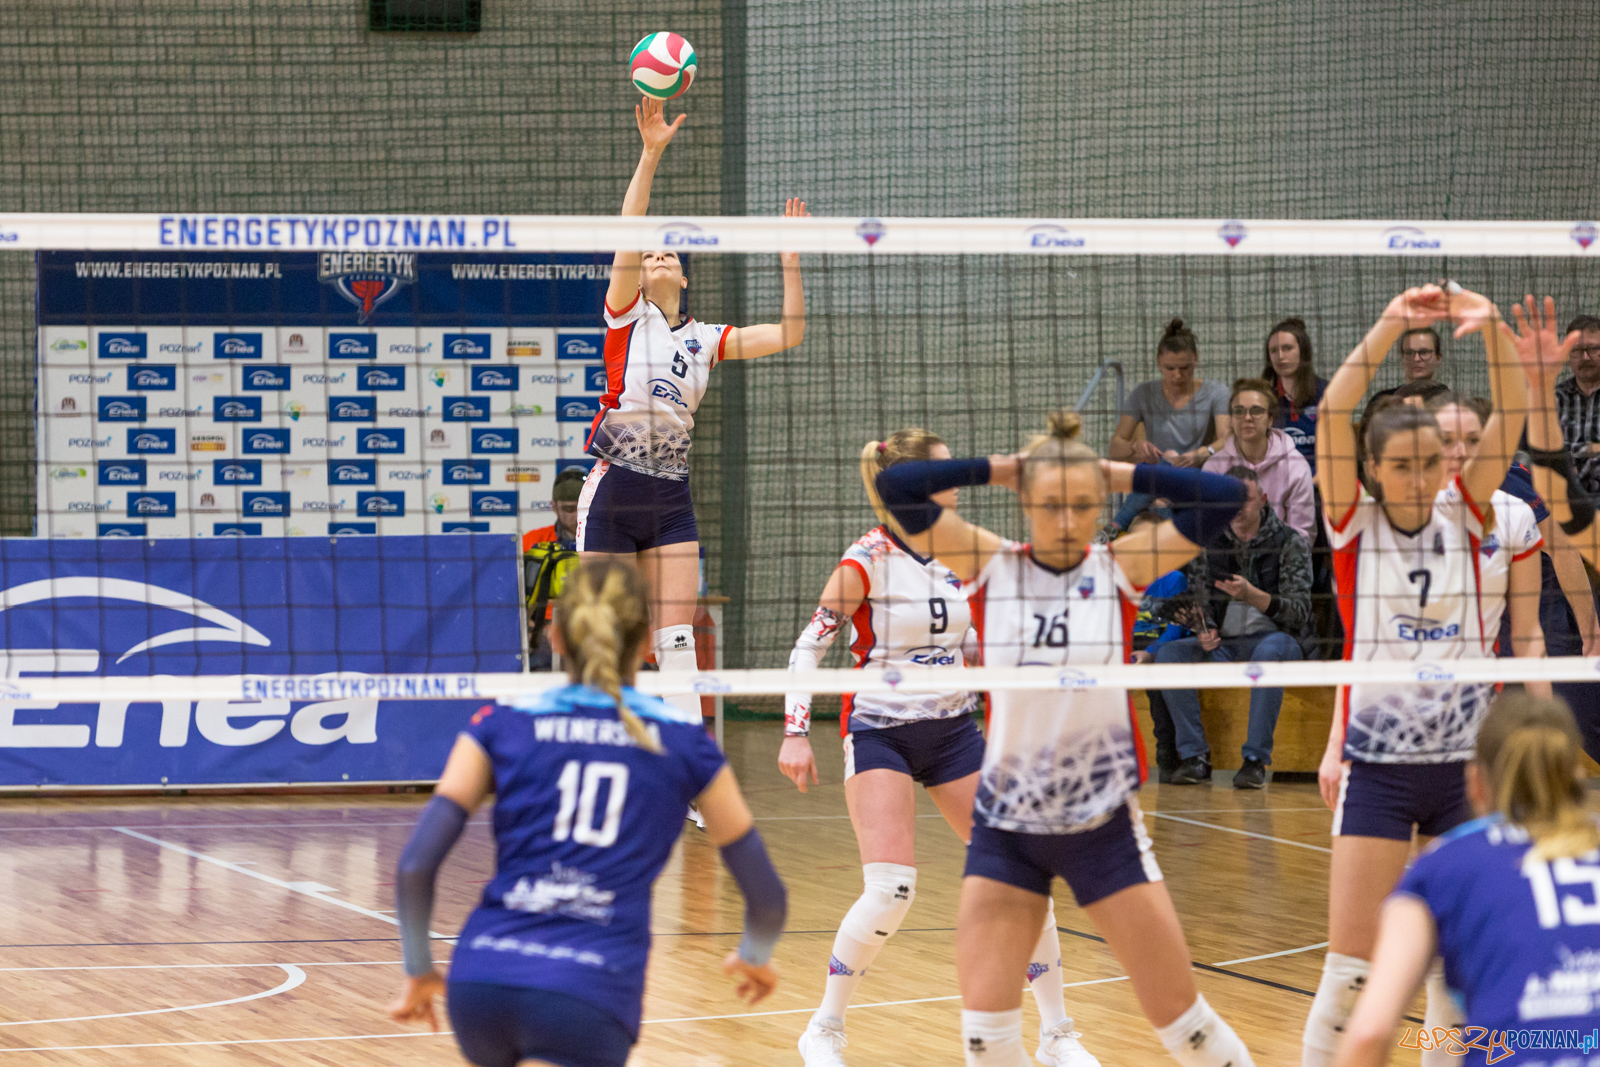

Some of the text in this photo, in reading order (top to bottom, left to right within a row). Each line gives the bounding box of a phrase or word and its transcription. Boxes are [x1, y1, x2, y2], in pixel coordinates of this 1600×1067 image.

[159, 217, 517, 247] ENERGETYKPOZNAN.PL
[75, 261, 282, 278] WWW.ENERGETYKPOZNAN.PL
[320, 252, 414, 279] ENERGETYK
[109, 343, 140, 353] Enea
[224, 342, 255, 353] Enea
[339, 342, 369, 354] Enea
[453, 342, 484, 354] Enea
[567, 342, 597, 354] Enea
[671, 350, 689, 379] 5
[137, 374, 168, 385] Enea
[253, 374, 284, 385] Enea
[367, 374, 398, 385] Enea
[481, 374, 511, 386] Enea
[108, 405, 139, 417] Enea
[224, 405, 254, 417] Enea
[338, 405, 369, 417] Enea
[452, 405, 483, 417] Enea
[137, 437, 168, 449] Enea
[252, 437, 284, 449] Enea
[367, 437, 398, 449] Enea
[481, 437, 512, 448] Enea
[1294, 436, 1316, 445] nea
[108, 468, 139, 481] Enea
[224, 468, 254, 480] Enea
[338, 468, 369, 480] Enea
[452, 468, 483, 480] Enea
[137, 501, 168, 513] Enea
[253, 501, 283, 513] Enea
[367, 501, 398, 513] Enea
[481, 501, 511, 513] Enea
[1408, 569, 1432, 608] 7
[928, 597, 949, 635] 9
[1033, 608, 1069, 648] 16
[1398, 623, 1460, 641] Enea
[242, 677, 482, 699] ENERGETYKPOZNAN.PL
[0, 649, 378, 748] Enea
[534, 716, 662, 747] WENERSA
[553, 759, 630, 848] 10
[1521, 851, 1600, 929] 15
